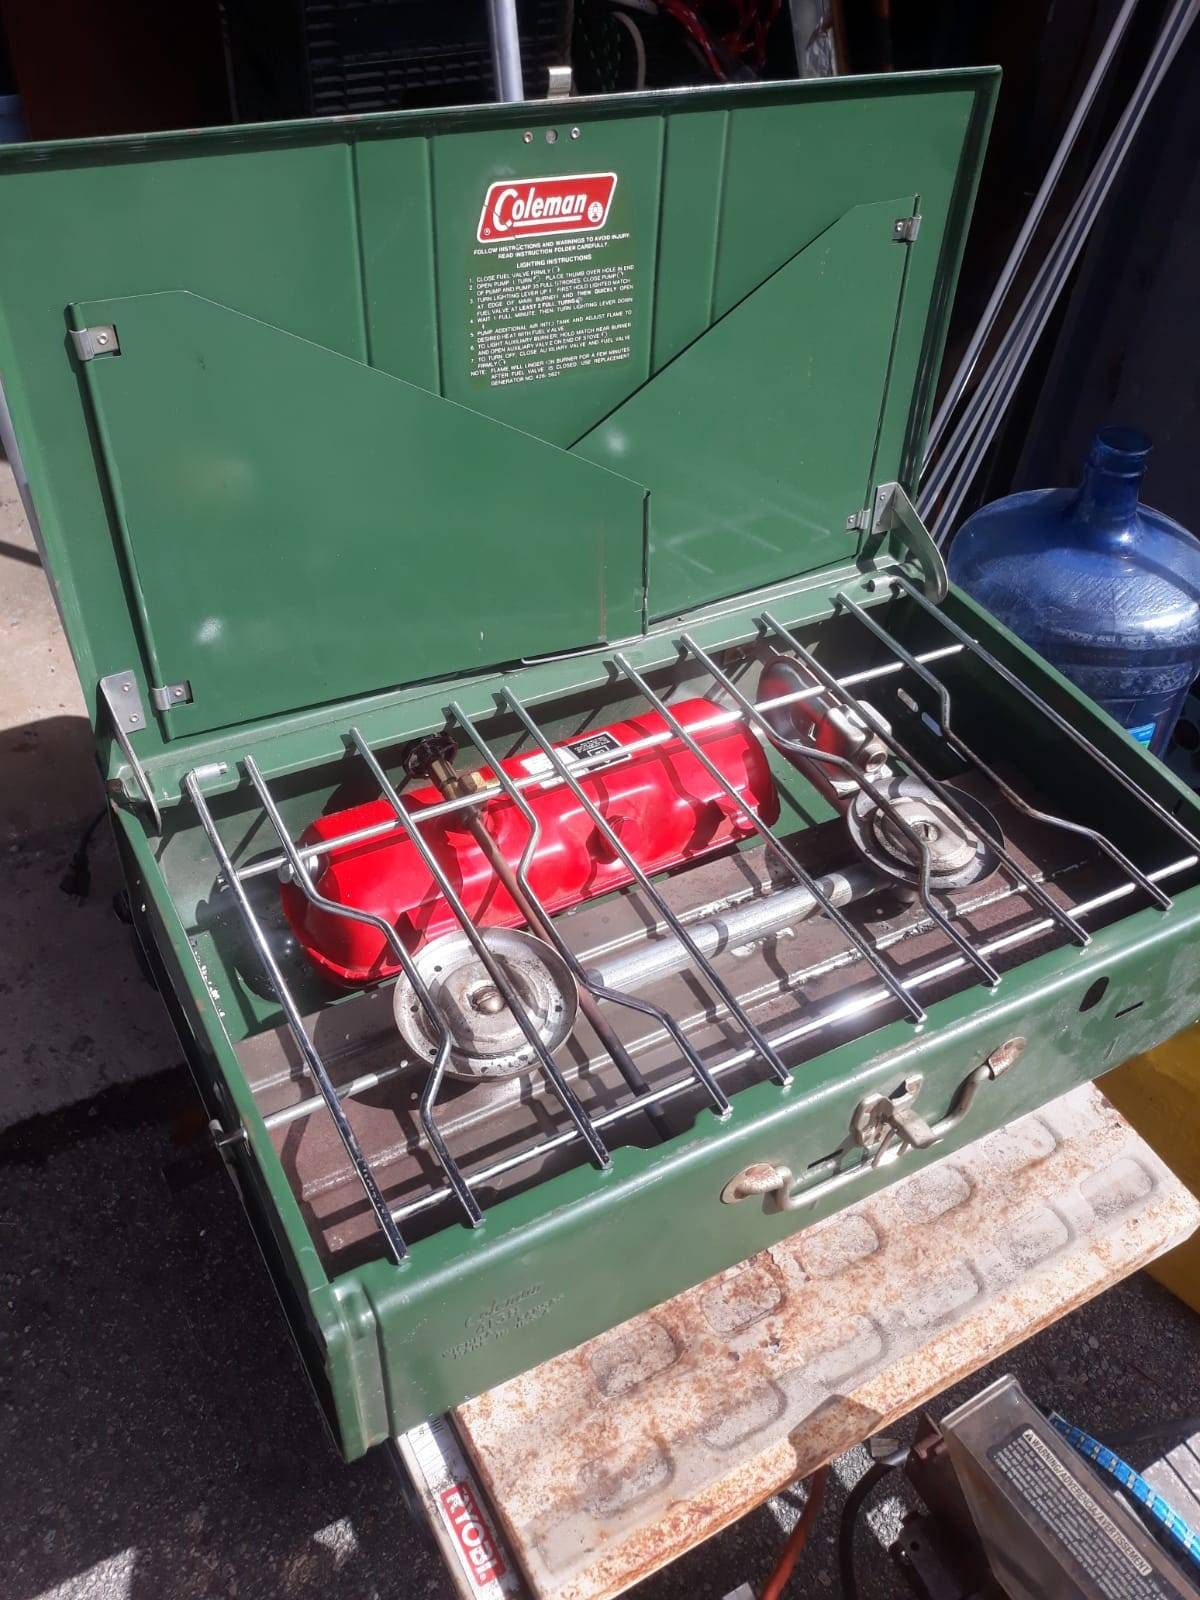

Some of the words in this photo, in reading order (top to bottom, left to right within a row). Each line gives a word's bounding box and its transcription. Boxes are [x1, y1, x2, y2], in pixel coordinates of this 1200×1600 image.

[493, 187, 587, 231] Coleman
[499, 243, 541, 252] INSTRUCTIONS
[556, 238, 585, 246] WARNINGS
[515, 248, 552, 257] INSTRUCTION
[554, 245, 576, 253] FOLDER
[517, 259, 545, 268] LIGHTING
[547, 254, 592, 265] INSTRUCTIONS
[494, 292, 520, 300] LIGHTING
[574, 302, 598, 310] LIGHTING
[495, 325, 526, 333] ADDITIONAL
[478, 335, 500, 343] DESIRED
[505, 337, 533, 345] AUXILIARY
[507, 343, 534, 351] AUXILIARY
[556, 355, 578, 363] BURNER
[609, 347, 630, 355] MINUTES
[594, 353, 630, 363] REPLACEMENT
[491, 377, 524, 386] GENERATOR
[446, 1488, 497, 1575] RYOBI
